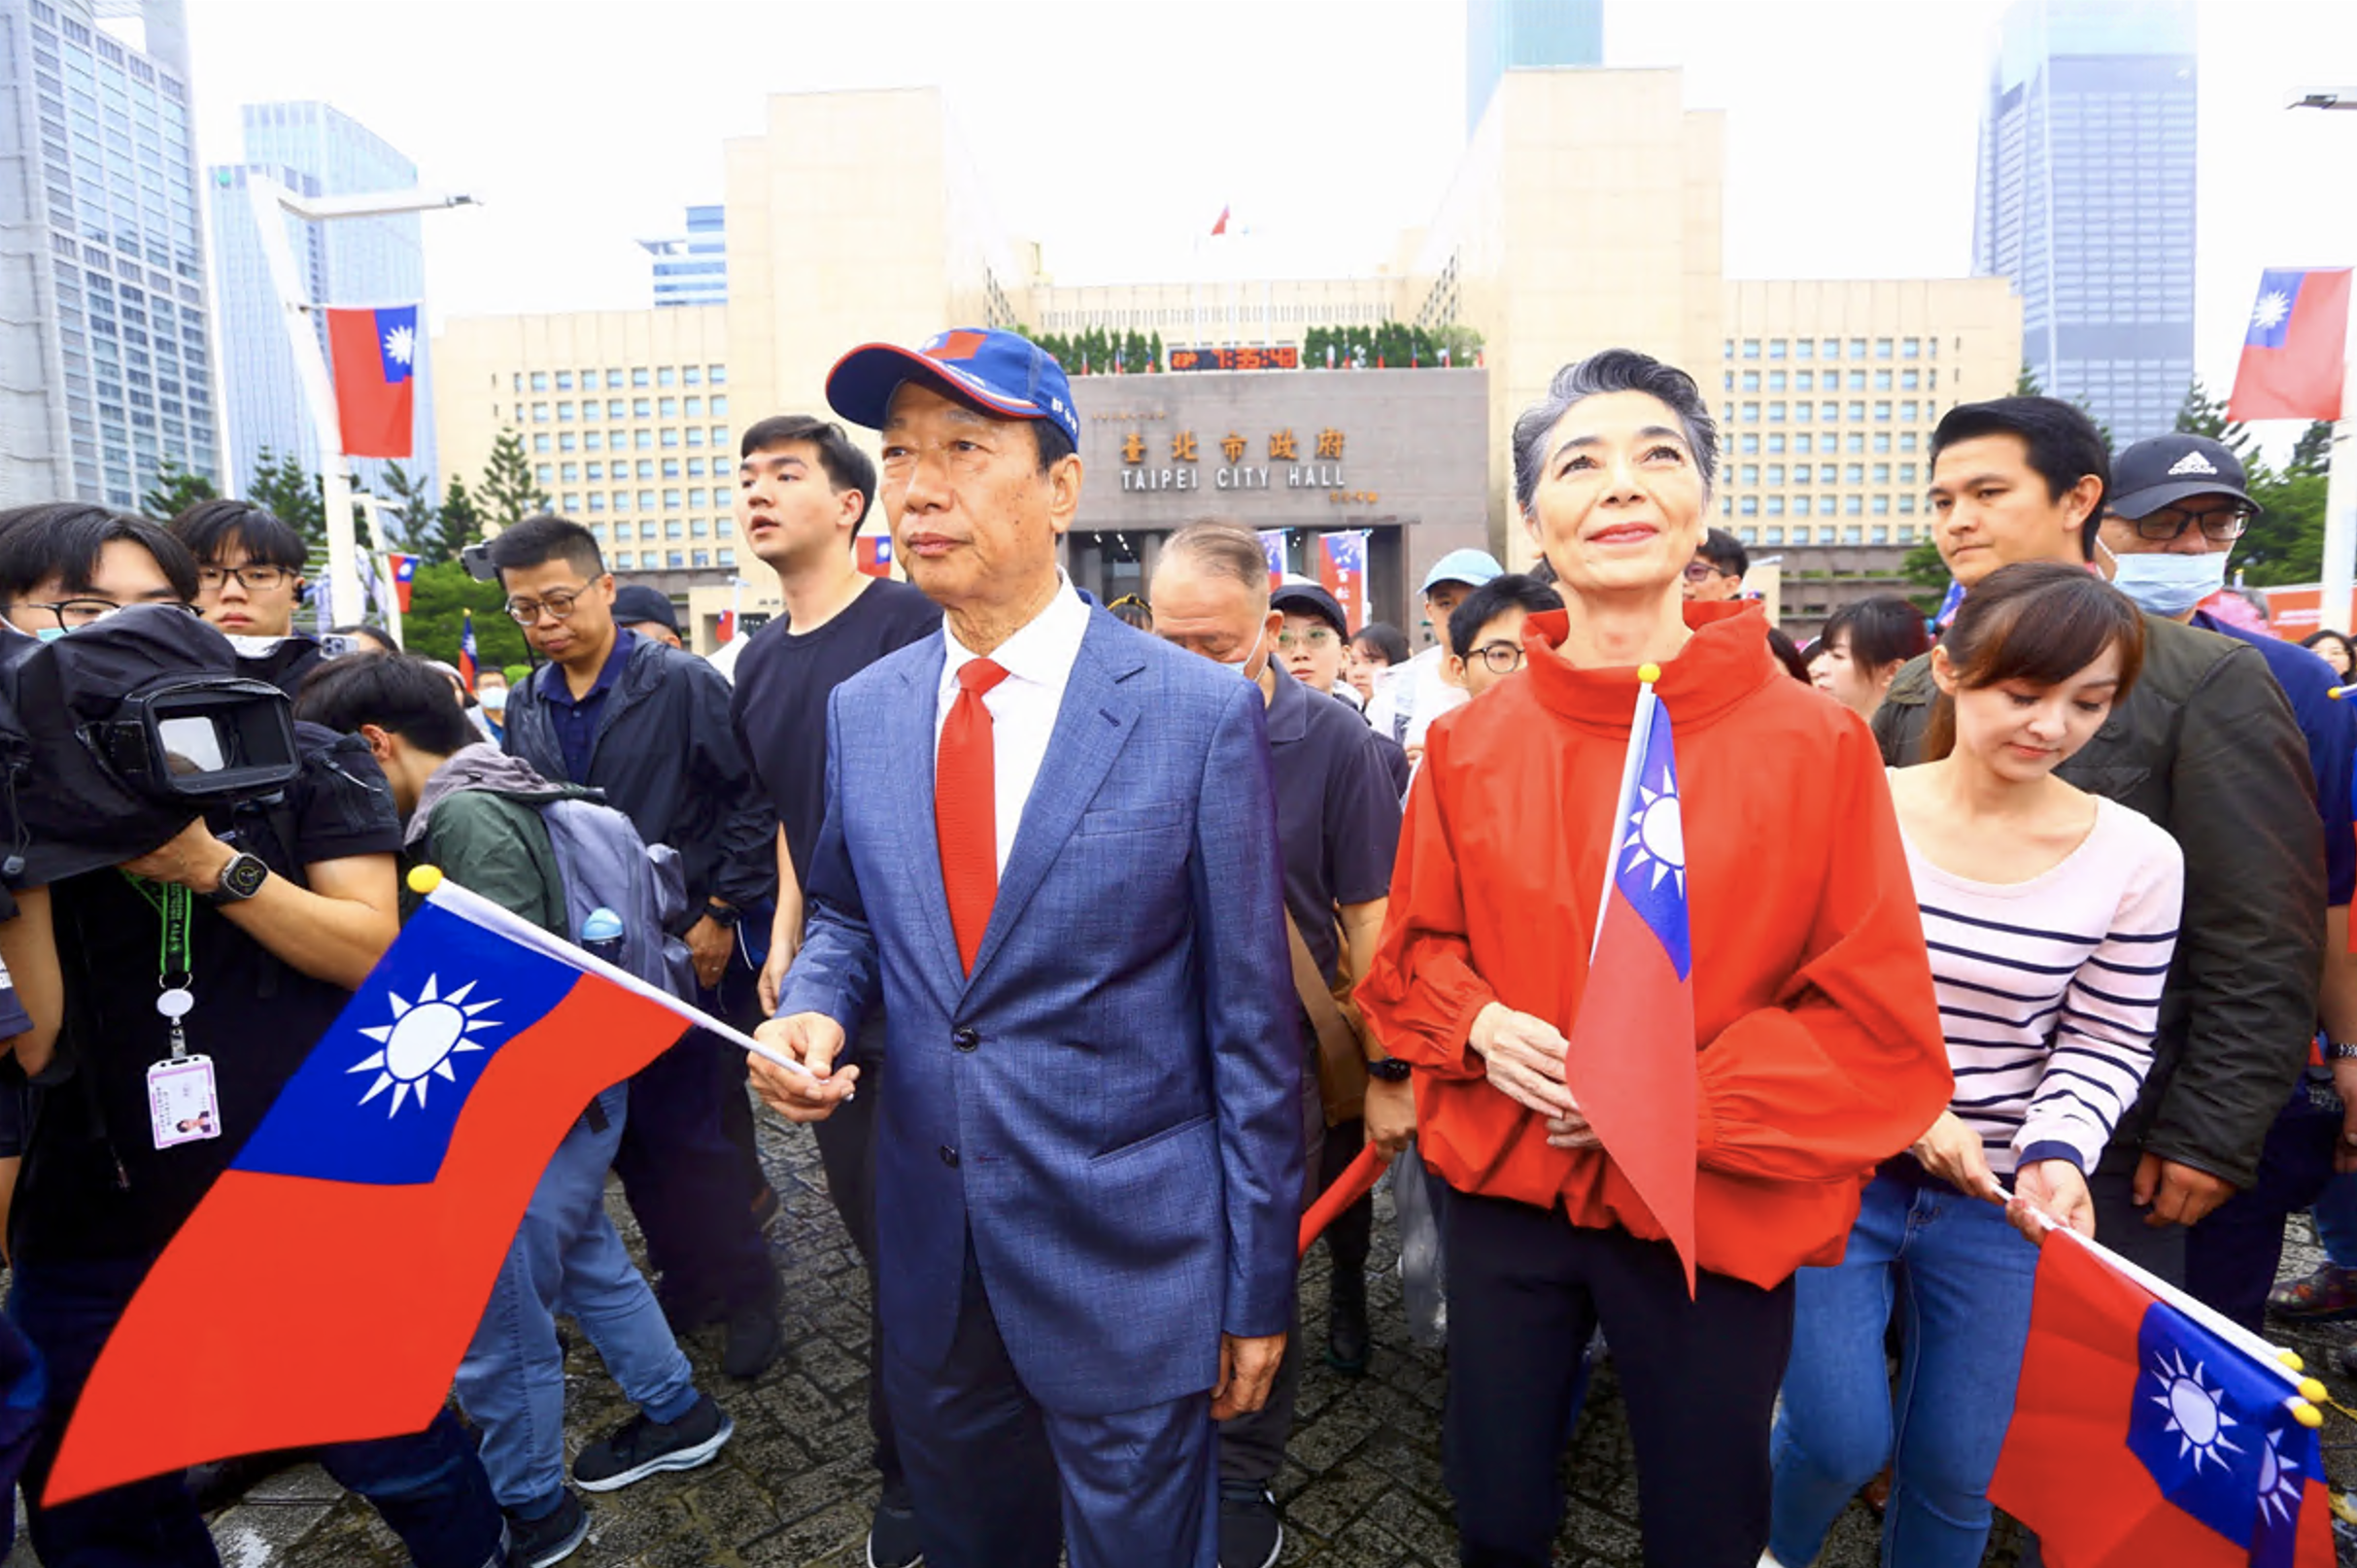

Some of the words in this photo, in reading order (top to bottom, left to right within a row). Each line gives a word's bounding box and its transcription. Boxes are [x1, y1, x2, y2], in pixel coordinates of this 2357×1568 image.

[1120, 426, 1346, 464] 臺北市政府
[1121, 468, 1198, 490] TAIPEI
[1216, 466, 1270, 488] CITY
[1288, 464, 1346, 486] HALL
